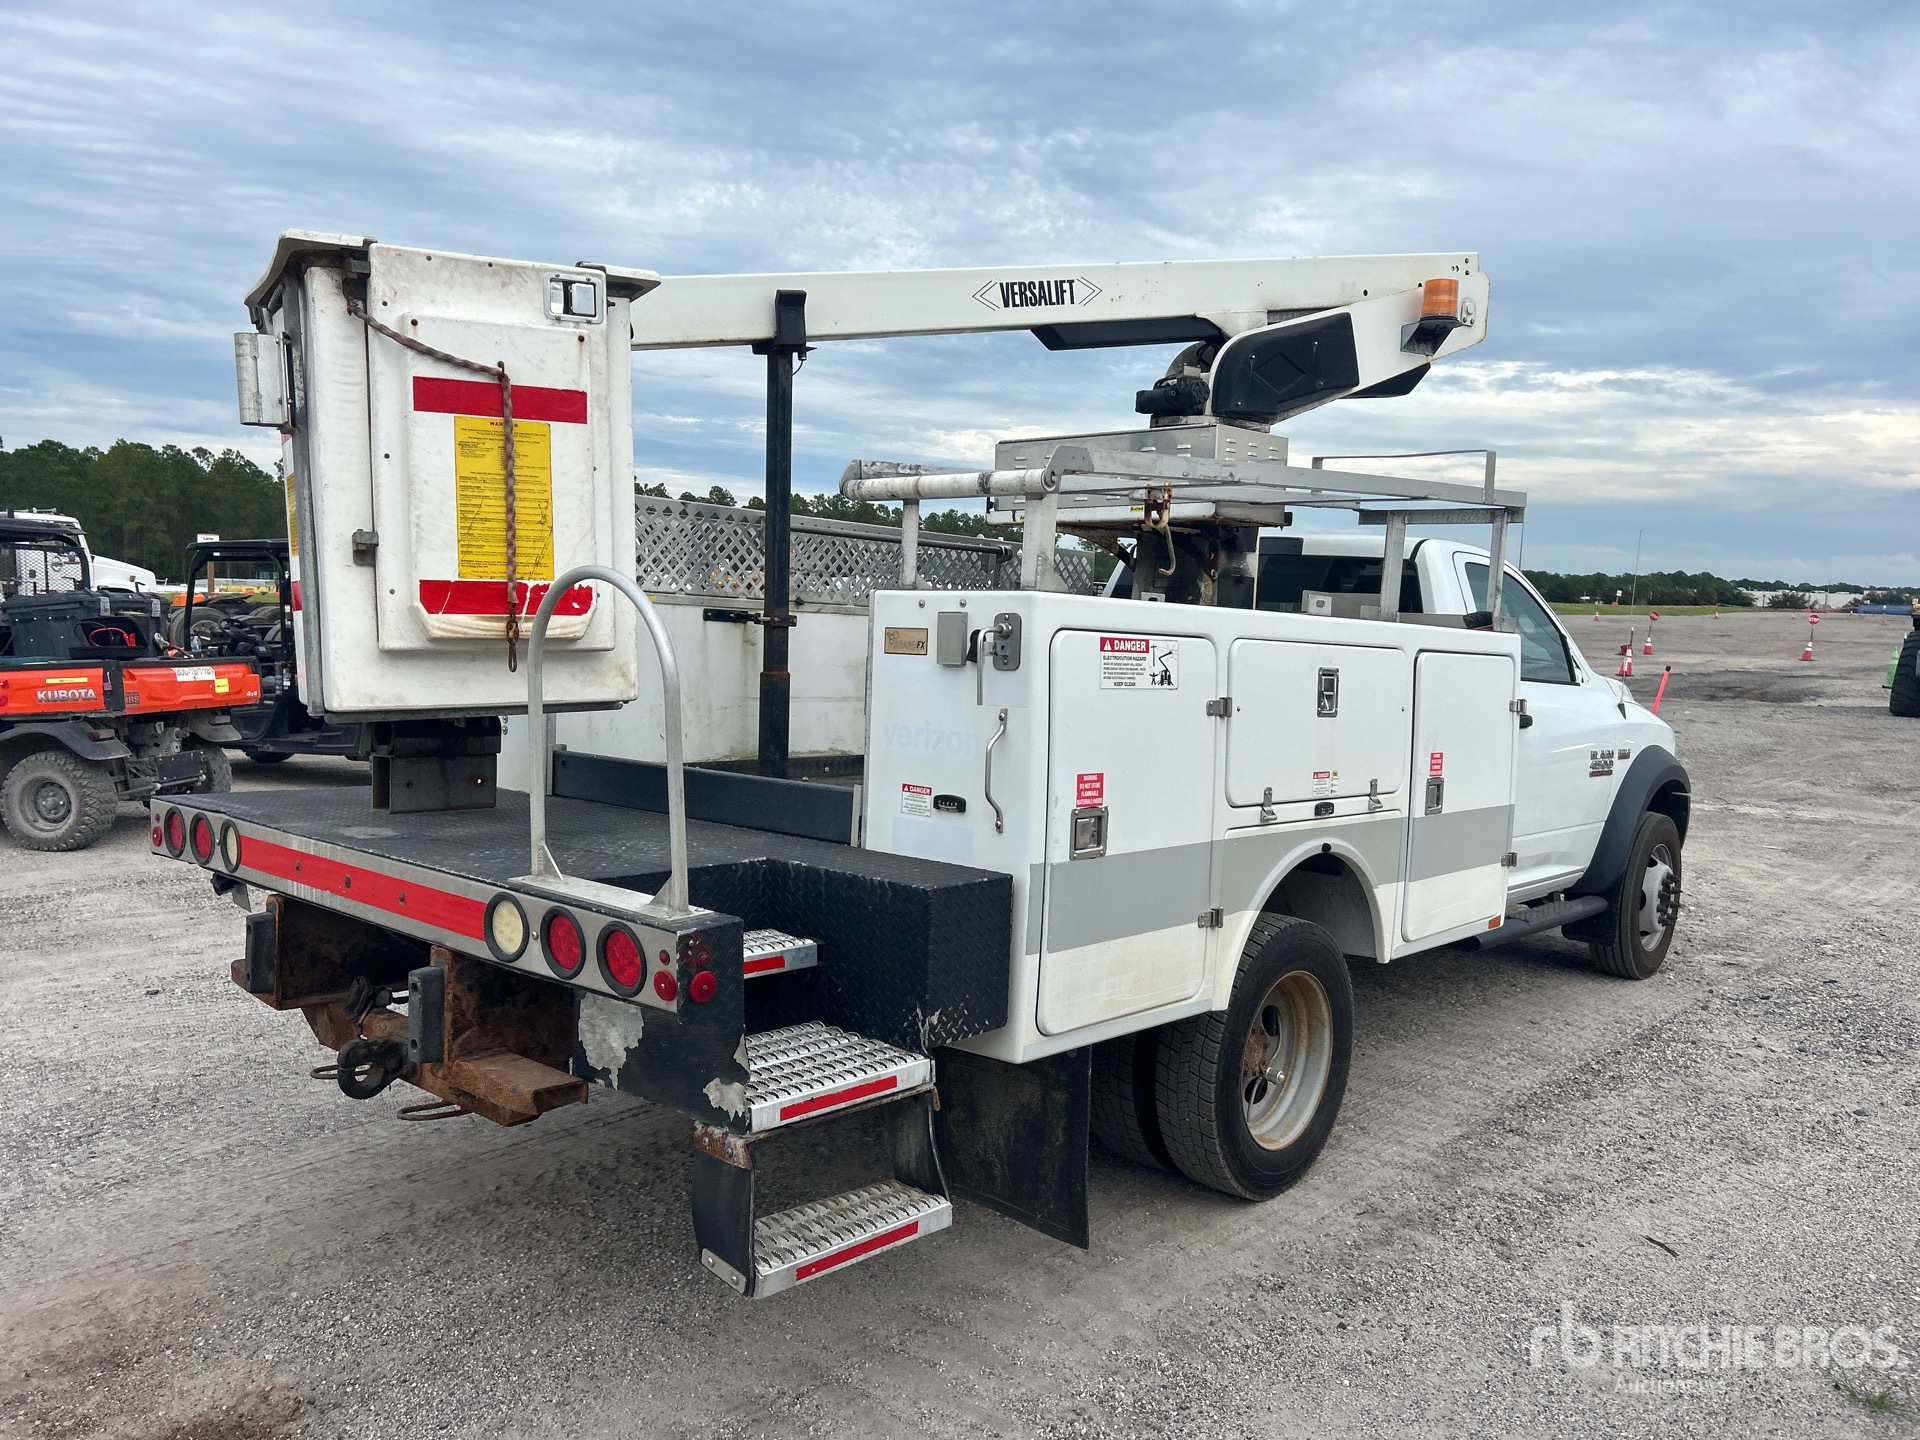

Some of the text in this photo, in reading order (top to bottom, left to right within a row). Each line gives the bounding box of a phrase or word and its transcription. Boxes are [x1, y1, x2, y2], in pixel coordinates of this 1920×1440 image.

[999, 279, 1075, 308] VERSALIFT
[1113, 639, 1147, 652] DANGER
[36, 688, 98, 703] KUBOTA
[909, 785, 931, 795] DANGER
